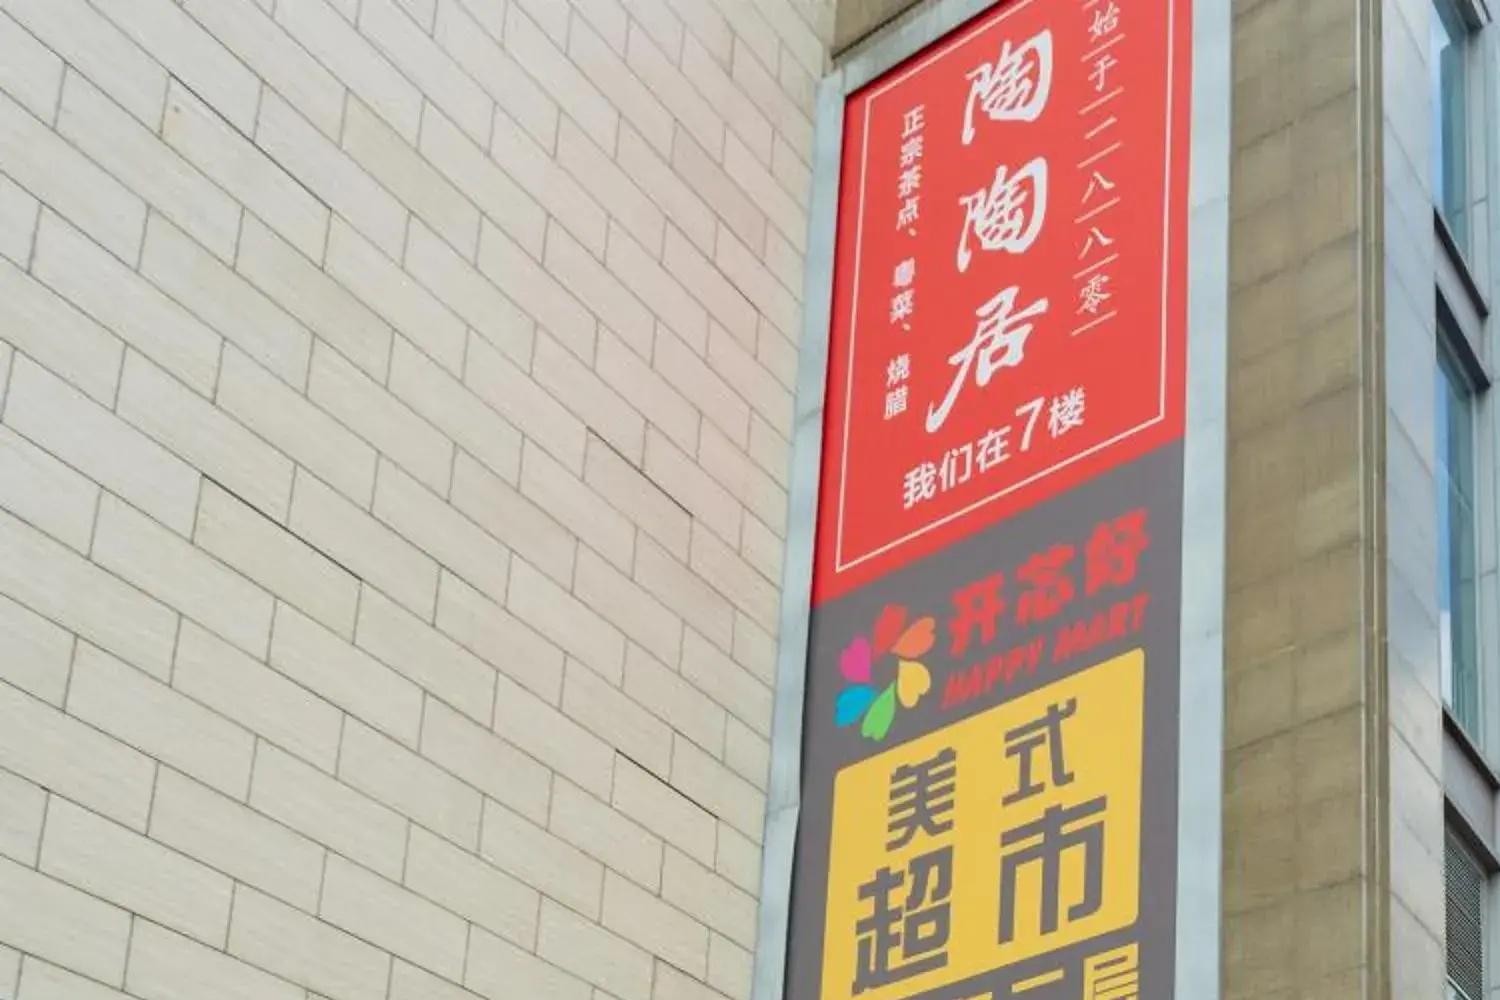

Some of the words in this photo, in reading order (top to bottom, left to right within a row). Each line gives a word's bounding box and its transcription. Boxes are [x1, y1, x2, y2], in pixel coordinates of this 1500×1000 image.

[926, 29, 1053, 433] 陶陶居
[902, 387, 1086, 509] 我们在7楼
[941, 635, 1046, 710] HAPPY
[1053, 592, 1149, 664] MART
[949, 508, 1149, 660] 开芯好
[886, 698, 1077, 852] 美式
[850, 795, 1107, 995] 超市
